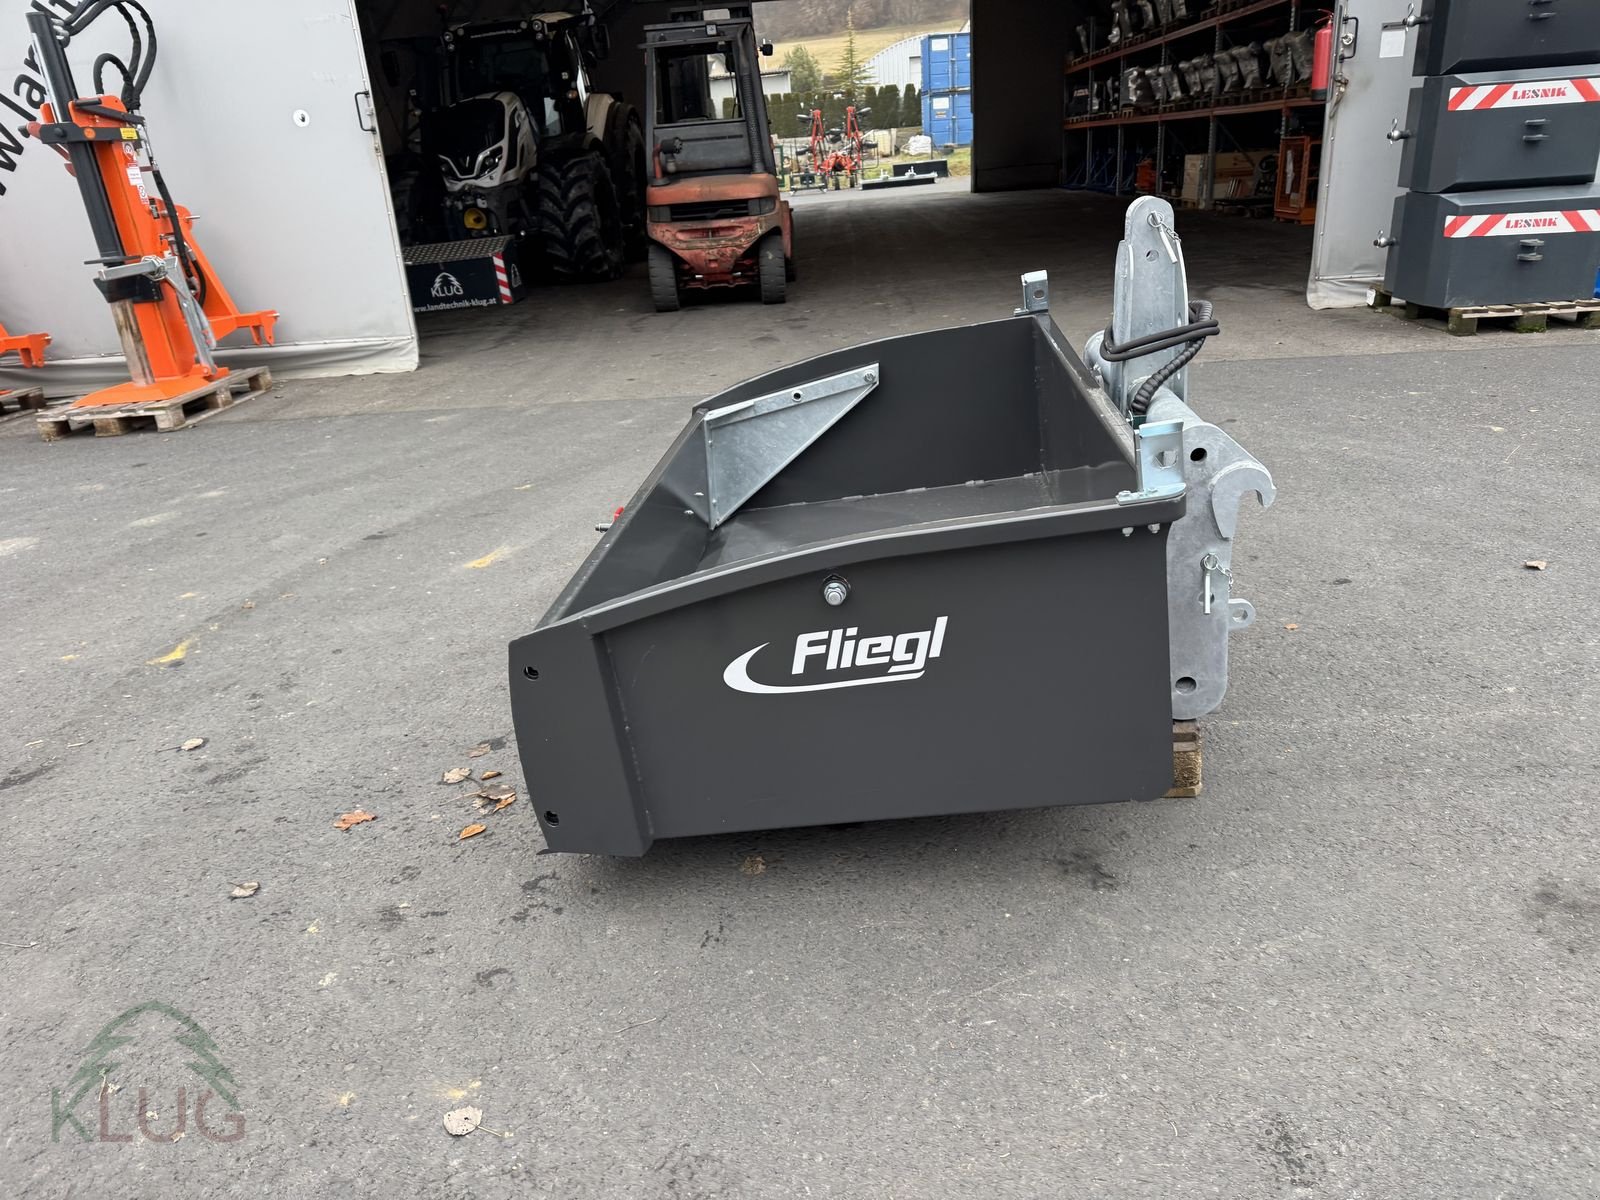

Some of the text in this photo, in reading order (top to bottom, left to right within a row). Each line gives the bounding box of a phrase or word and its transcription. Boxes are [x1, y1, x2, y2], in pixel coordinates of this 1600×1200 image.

[1512, 87, 1567, 100] LESNIK
[1505, 217, 1558, 229] LESNIK
[430, 286, 464, 298] KLUG
[413, 298, 497, 312] ww.landtechnik-klug.at
[791, 615, 949, 675] Fliegl
